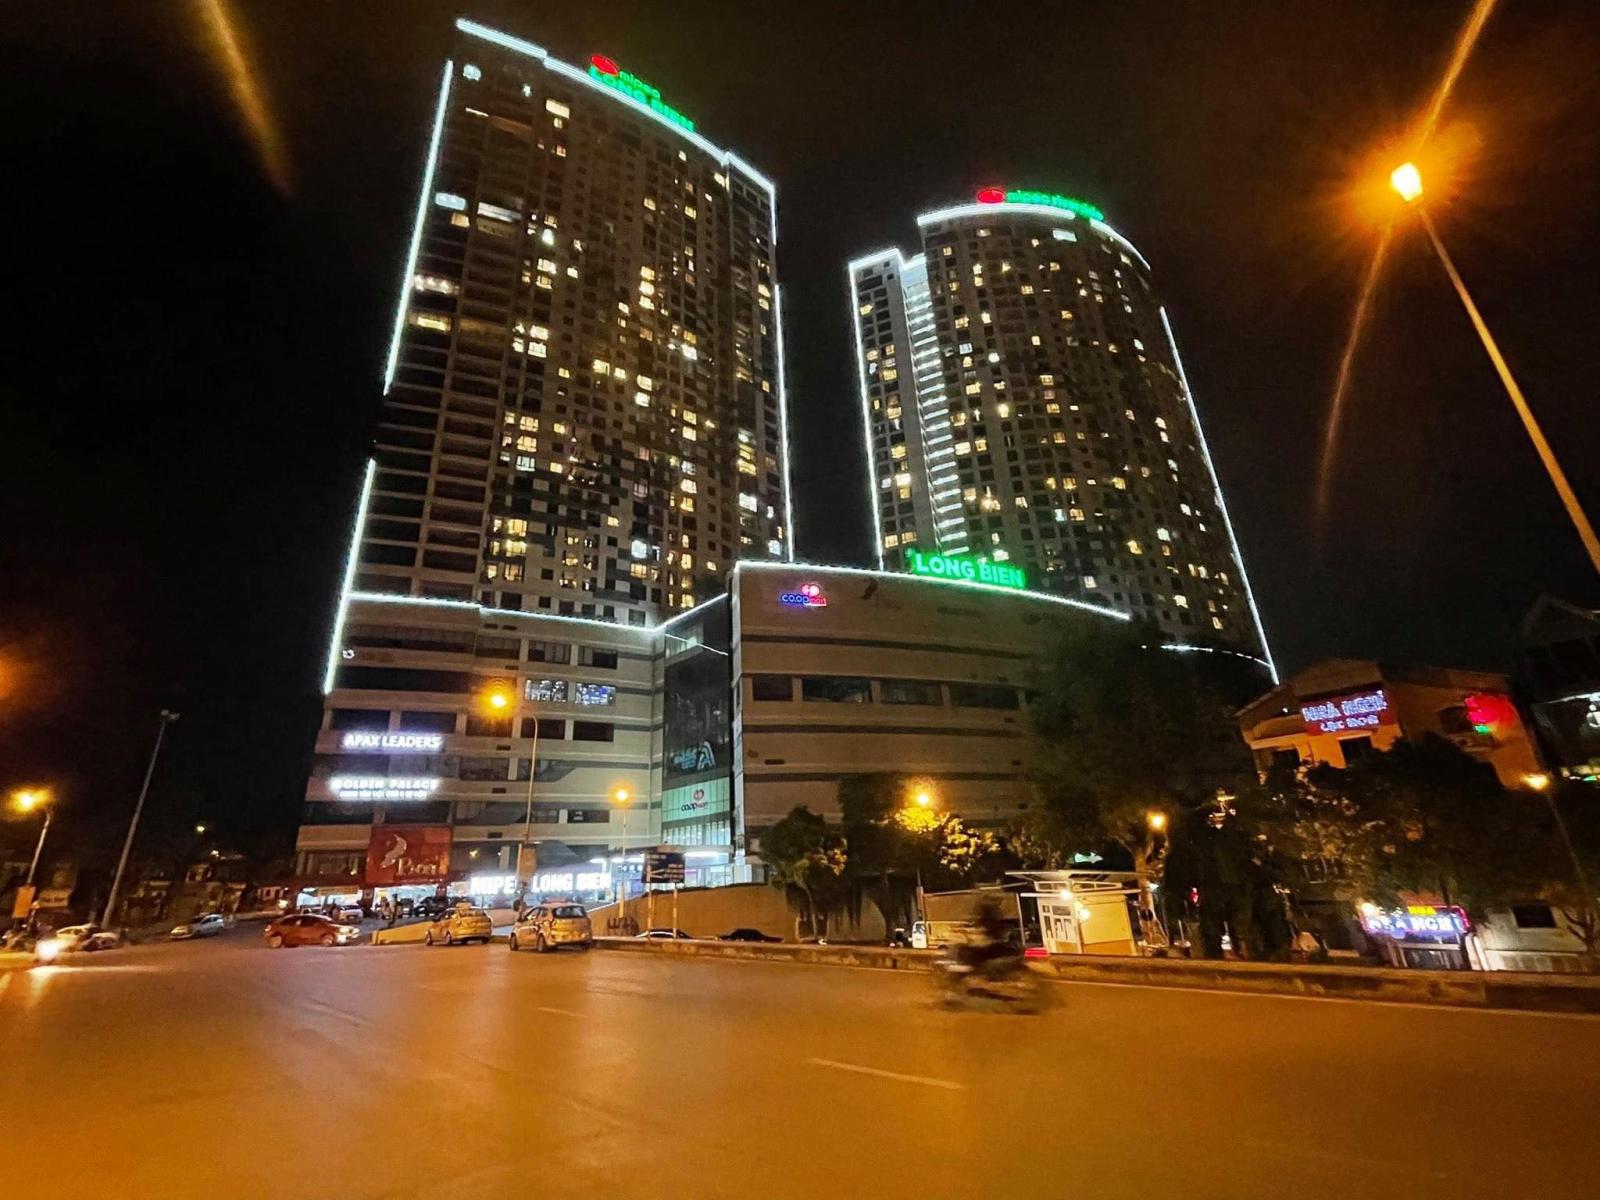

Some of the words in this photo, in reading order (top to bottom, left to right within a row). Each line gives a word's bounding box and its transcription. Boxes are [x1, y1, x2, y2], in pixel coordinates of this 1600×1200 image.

[915, 553, 976, 578] LONG
[979, 563, 1025, 588] BIEN
[344, 733, 379, 747] APAX
[381, 735, 442, 749] LEADERS
[330, 778, 385, 790] GOLDEN
[532, 873, 573, 892] LONG
